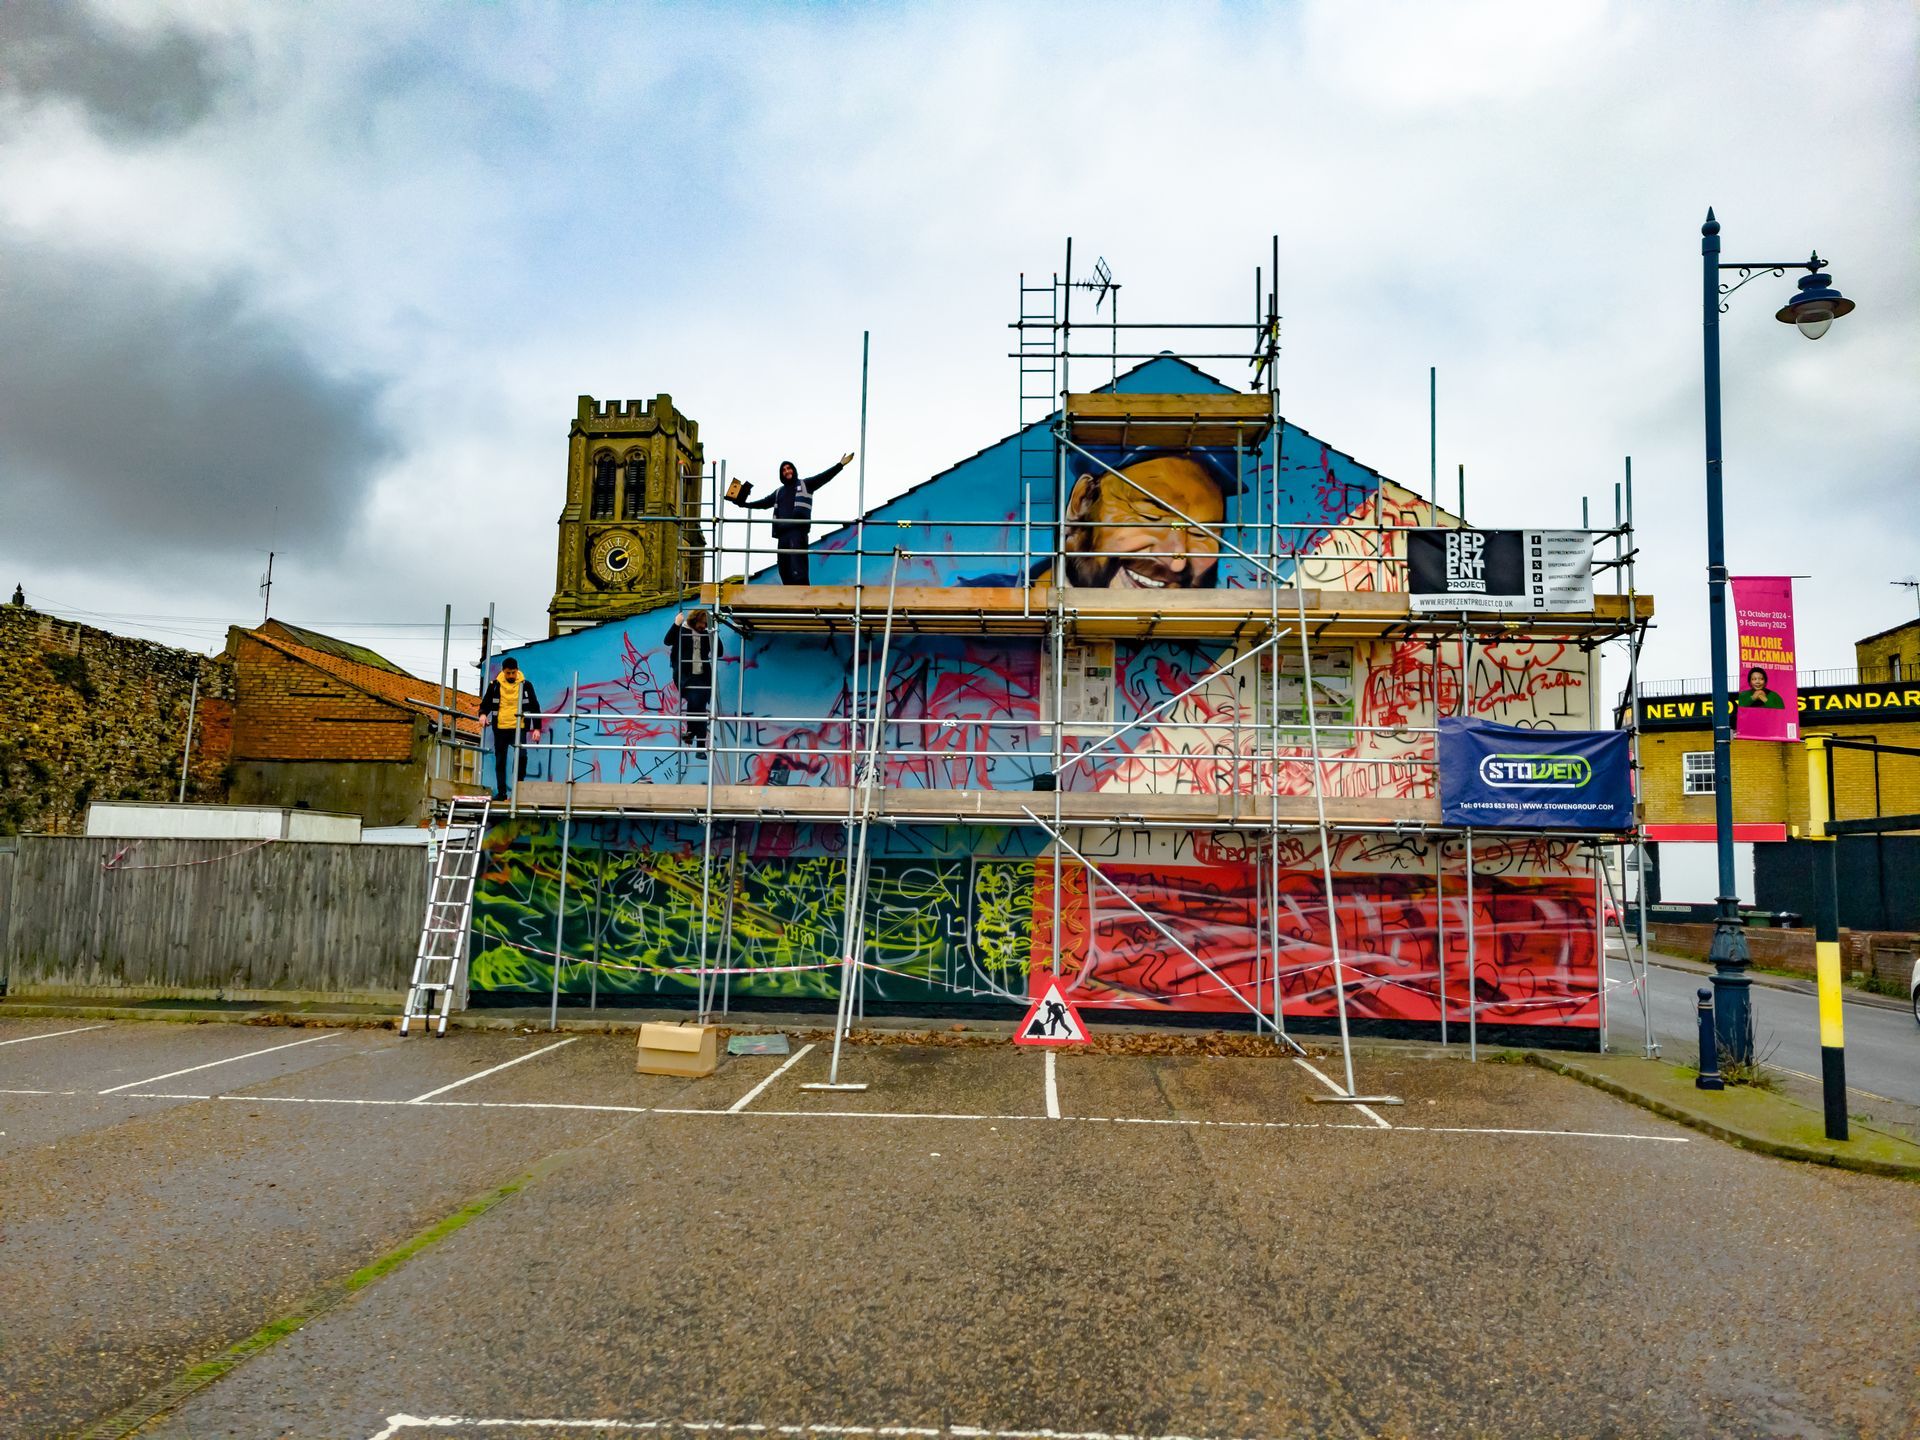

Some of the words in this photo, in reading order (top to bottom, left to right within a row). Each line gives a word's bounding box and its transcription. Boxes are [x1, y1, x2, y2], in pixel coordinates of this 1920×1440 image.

[1445, 532, 1486, 548] REP
[1446, 548, 1484, 563] REZ
[1446, 560, 1486, 579] ENT
[1446, 580, 1486, 589] PROJECT
[1419, 597, 1514, 608] WWW.REPREZENTPROJECT.CO.UK
[1747, 610, 1771, 619] October
[1772, 611, 1787, 619] 2024
[1745, 619, 1771, 629] February
[1772, 621, 1787, 629] 2025
[1740, 635, 1783, 650] MALORIE
[1741, 648, 1794, 664] BLACKMAN
[1647, 702, 1695, 719] NEW
[1488, 761, 1582, 780] STOWEN
[1523, 803, 1614, 811] WWW.STOWENGROUP.COM
